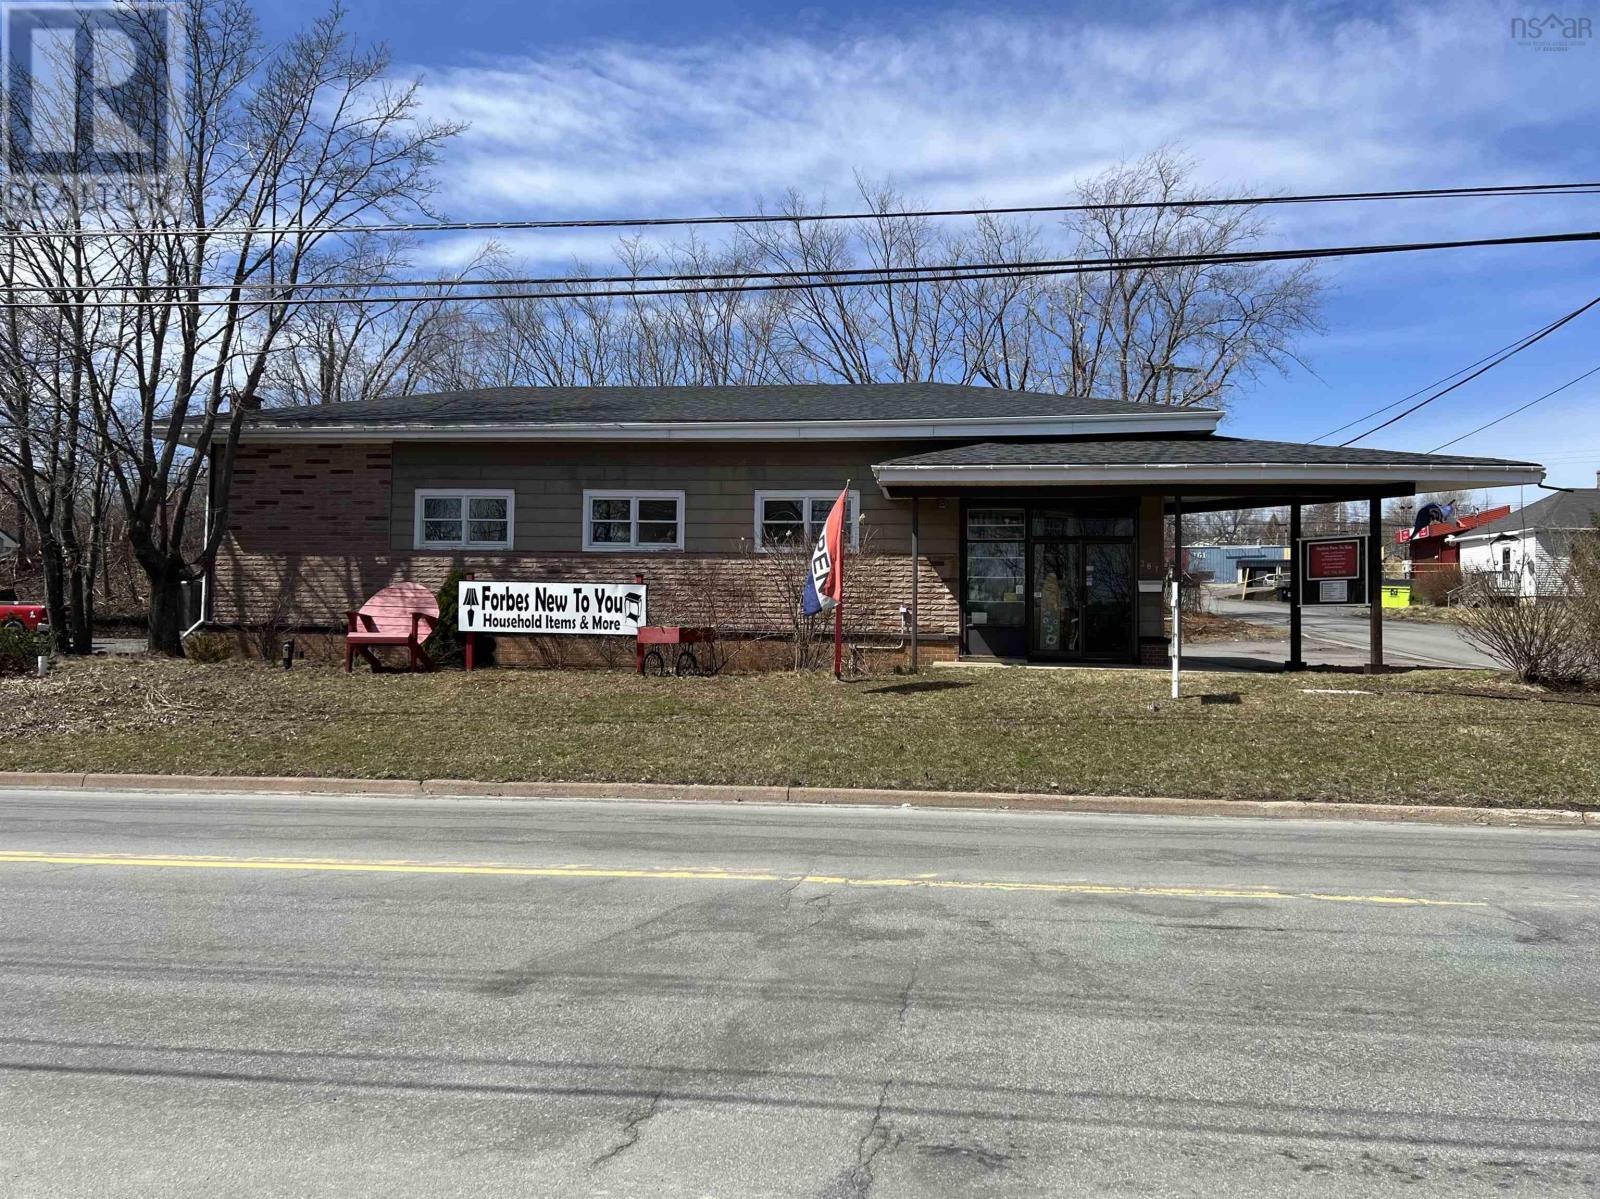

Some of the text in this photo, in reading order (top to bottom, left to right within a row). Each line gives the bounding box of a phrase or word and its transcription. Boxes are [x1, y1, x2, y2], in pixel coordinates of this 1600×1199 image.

[813, 533, 830, 594] PEN
[481, 585, 623, 614] Forbes New To You
[483, 613, 621, 630] Household Items & More
